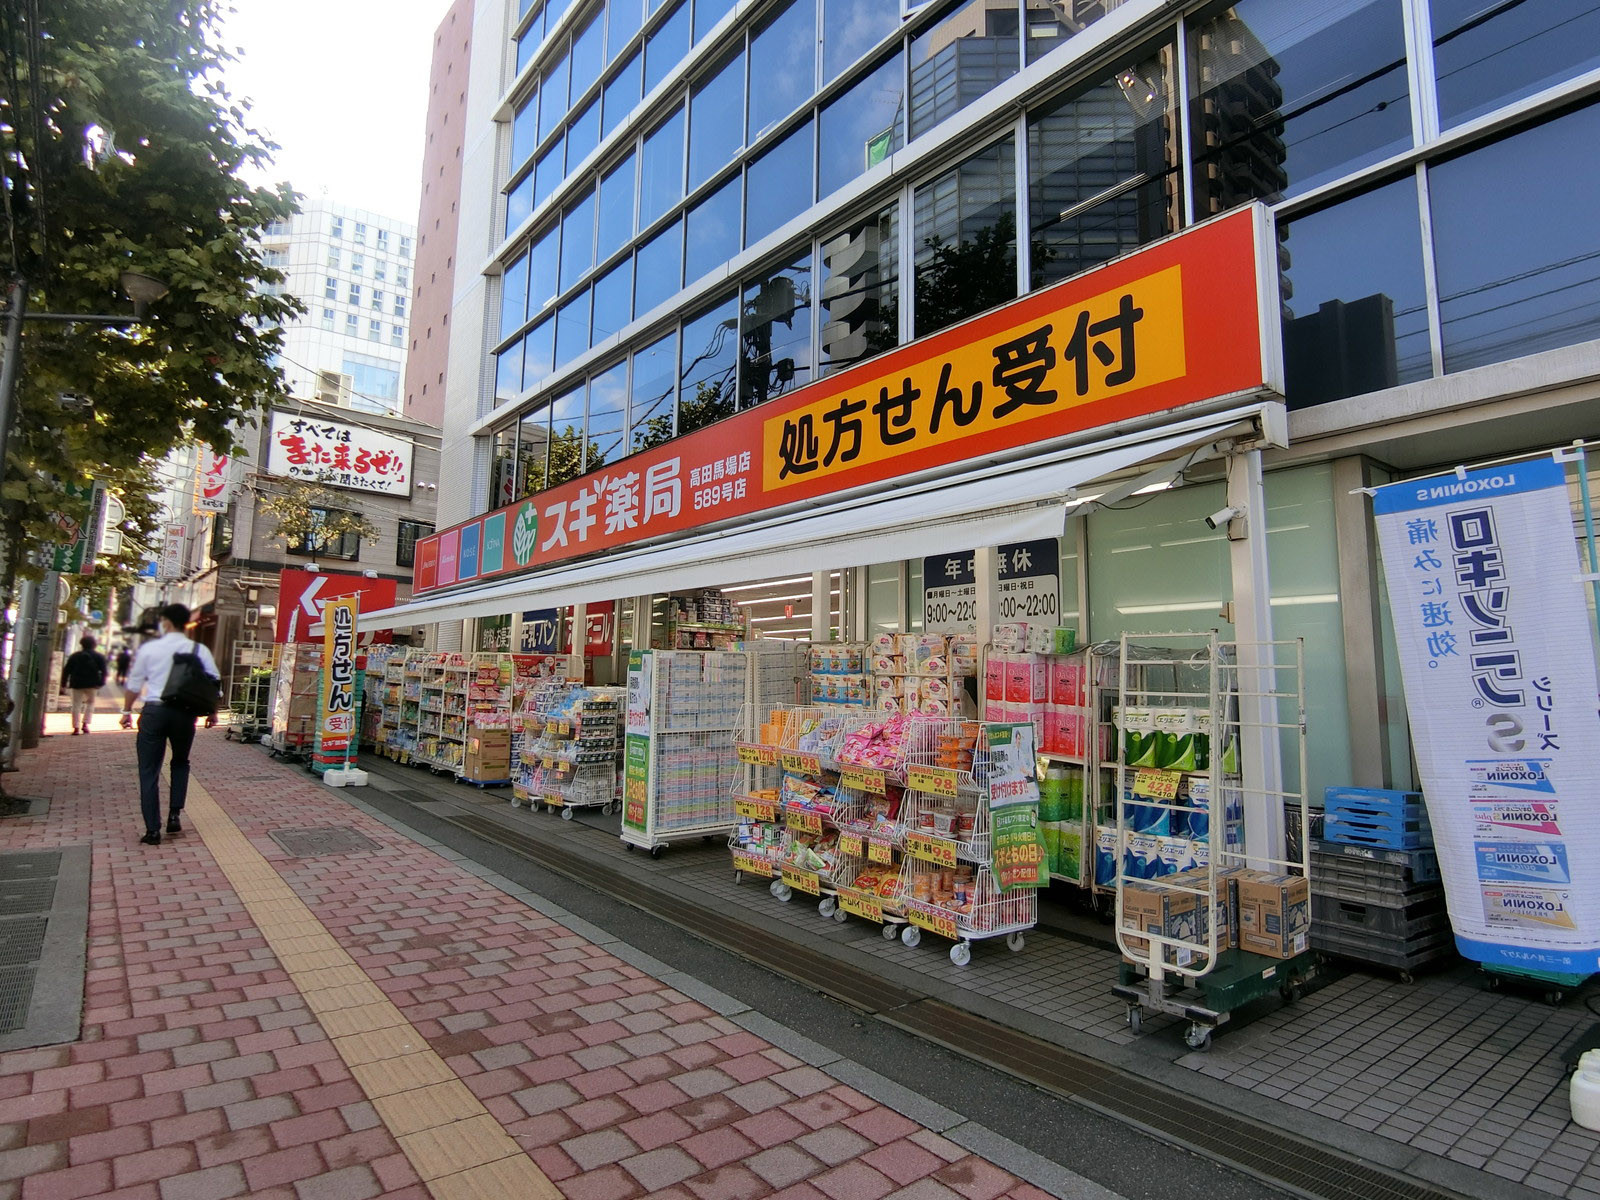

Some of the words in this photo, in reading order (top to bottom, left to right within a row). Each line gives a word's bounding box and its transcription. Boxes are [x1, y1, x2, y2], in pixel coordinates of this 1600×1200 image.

[779, 294, 1144, 480] 処方せん受付
[290, 418, 351, 442] すべては
[690, 451, 751, 488] 高田馬場店
[542, 457, 682, 552] スギ薬局
[693, 478, 747, 511] 589号店
[927, 600, 976, 624] 9:00~22:0
[1000, 593, 1056, 618] :00~22:00
[327, 606, 354, 711] 処方せん
[1099, 835, 1117, 843] エリエー
[1129, 839, 1155, 848] エリエール
[1159, 846, 1184, 855] エリエール
[839, 894, 860, 906] ホームパイ
[860, 901, 879, 914] 198
